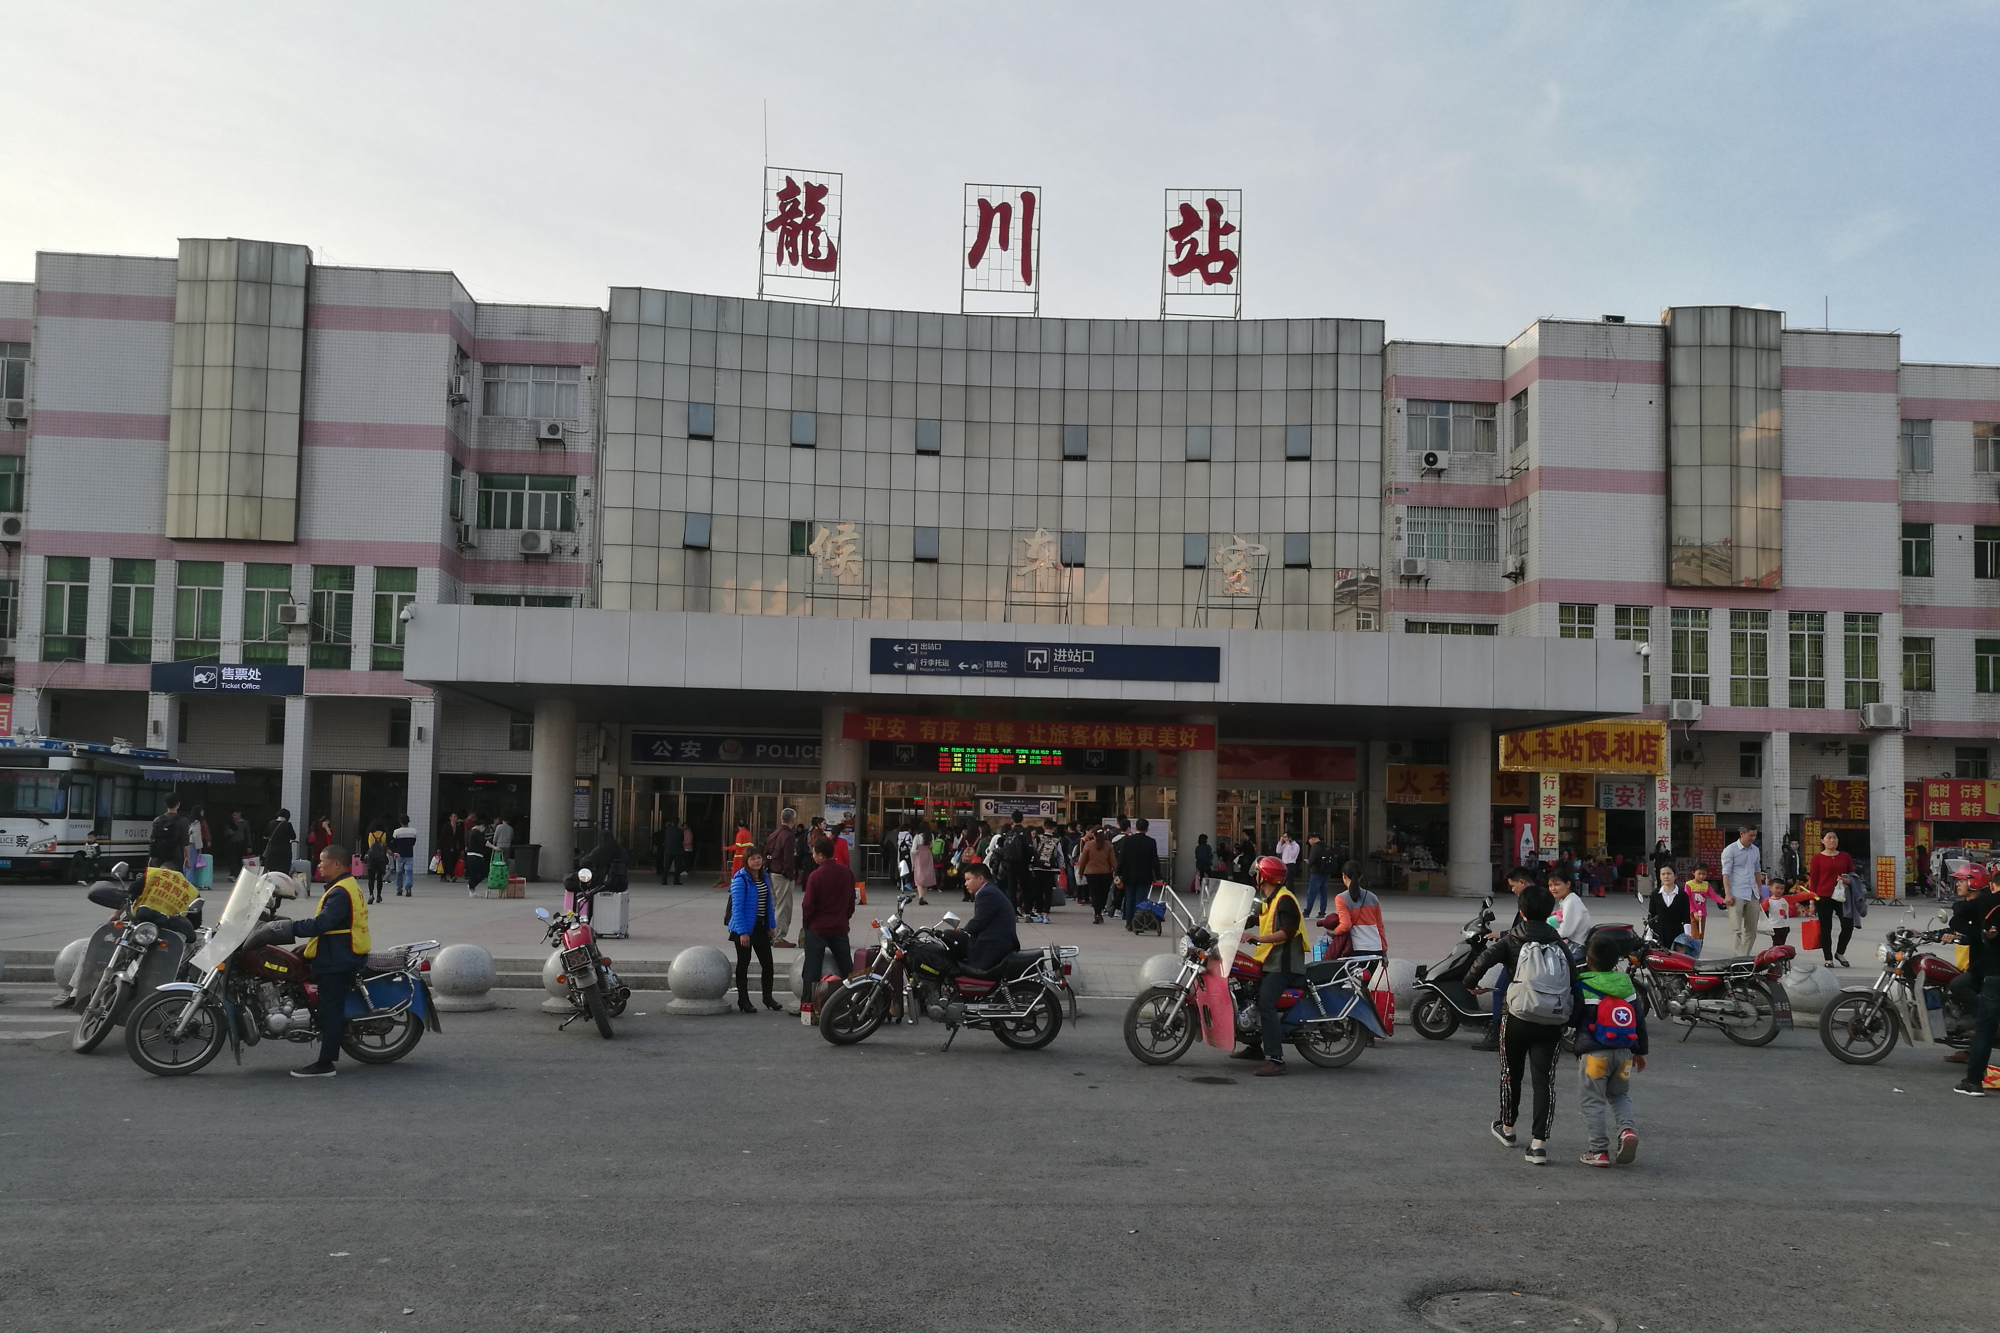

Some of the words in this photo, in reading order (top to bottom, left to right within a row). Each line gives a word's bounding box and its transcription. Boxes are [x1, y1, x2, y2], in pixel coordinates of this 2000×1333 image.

[1053, 648, 1094, 663] 进站口
[920, 659, 949, 667] 行李托运
[986, 660, 1008, 669] 售票处
[1053, 665, 1085, 674] Entrance
[221, 667, 261, 681] 售票处
[241, 682, 260, 690] Office
[865, 717, 907, 741] 平安
[919, 718, 961, 742] 有序
[973, 720, 1015, 743] 温馨
[1028, 723, 1199, 749] 让旅客体验更美好
[651, 740, 702, 758] 公安
[1504, 728, 1661, 766] 火车站便利店
[1602, 784, 1613, 808] 正宗
[1821, 779, 1868, 800] 惠景
[1928, 783, 1950, 798] 临时
[1960, 784, 1982, 799] 行李
[1542, 775, 1557, 848] 行李寄存
[1822, 799, 1867, 820] 住宿
[1928, 801, 1950, 816] 住宿
[1960, 802, 1982, 817] 寄存
[16, 834, 29, 848] 察
[125, 829, 149, 838] POLICE
